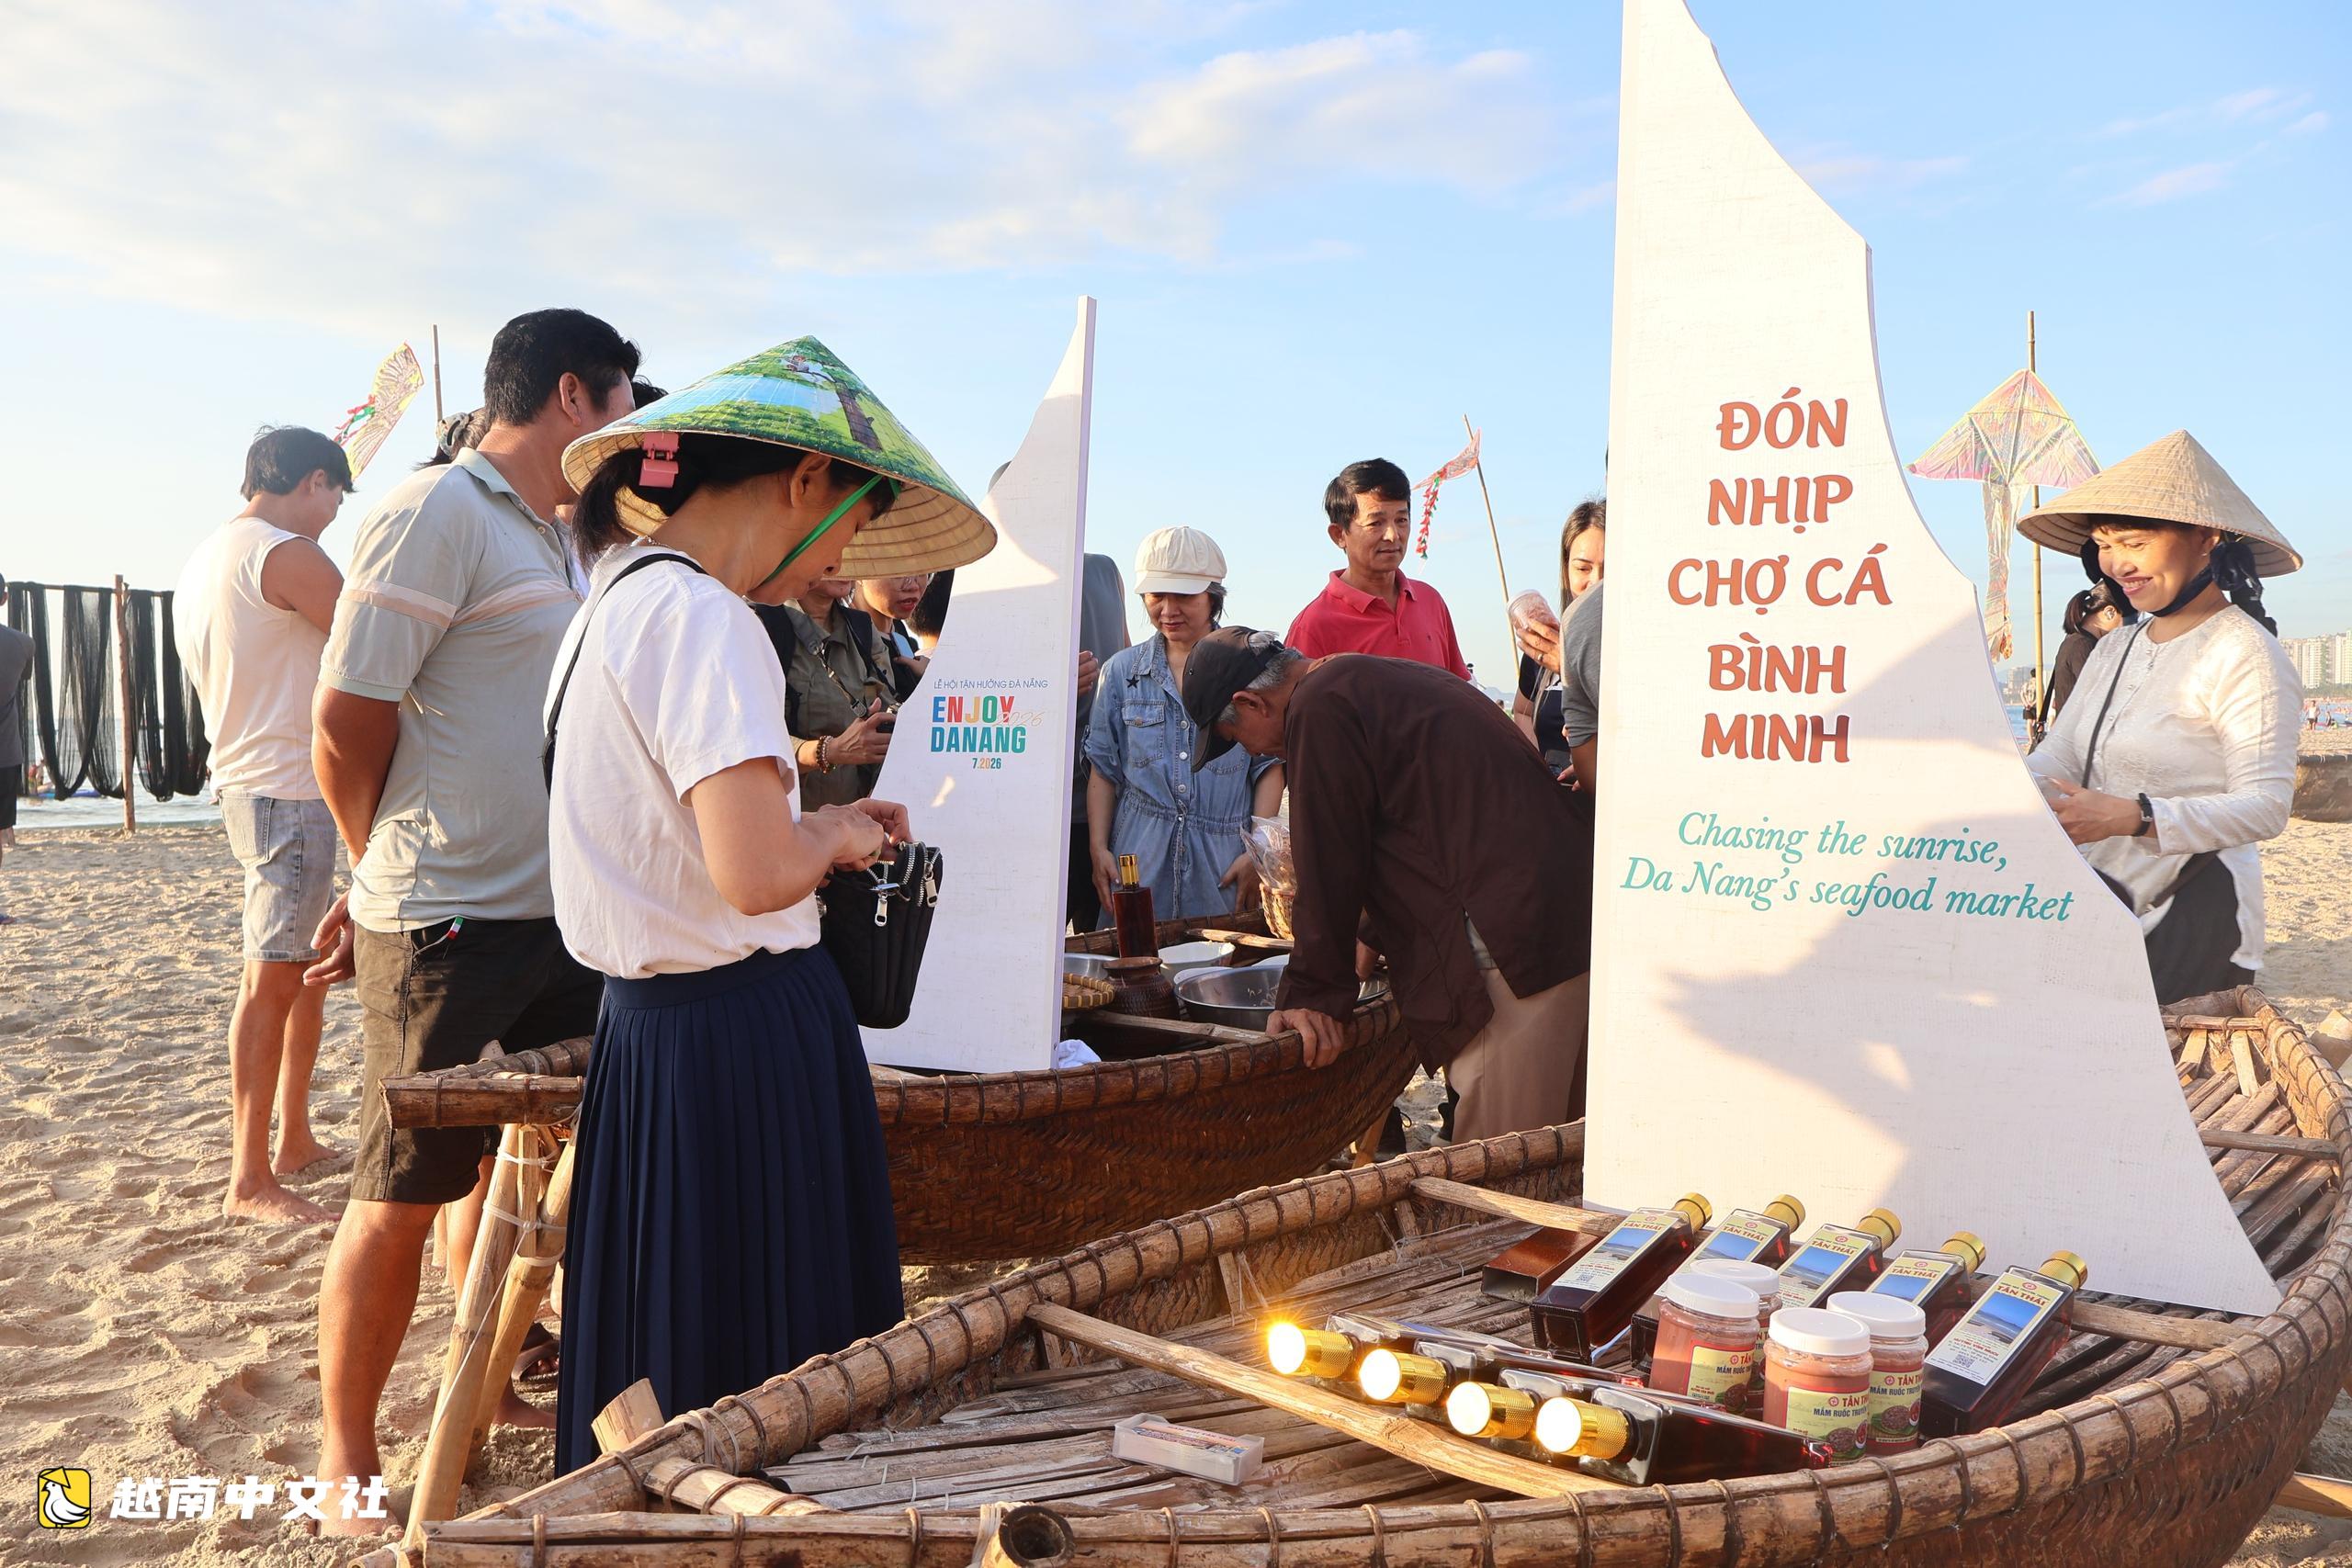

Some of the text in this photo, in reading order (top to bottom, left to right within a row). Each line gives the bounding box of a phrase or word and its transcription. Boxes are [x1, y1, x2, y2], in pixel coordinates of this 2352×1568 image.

[1715, 387, 1848, 450] ĐÓN
[1708, 474, 1853, 533] NHỊP
[1668, 543, 1893, 615] CHỢ CÁ
[944, 679, 958, 690] HỘI
[1708, 632, 1846, 694] BÌNH
[932, 695, 1015, 724] ENJOY
[931, 727, 1026, 753] DANANG
[972, 758, 1001, 769] 7.2026
[1701, 713, 1849, 763] MINH
[1678, 812, 2007, 871] Chasing the sunrise,
[1620, 857, 2074, 921] Da Nang's seafood market
[1842, 1394, 1860, 1407] TÂN
